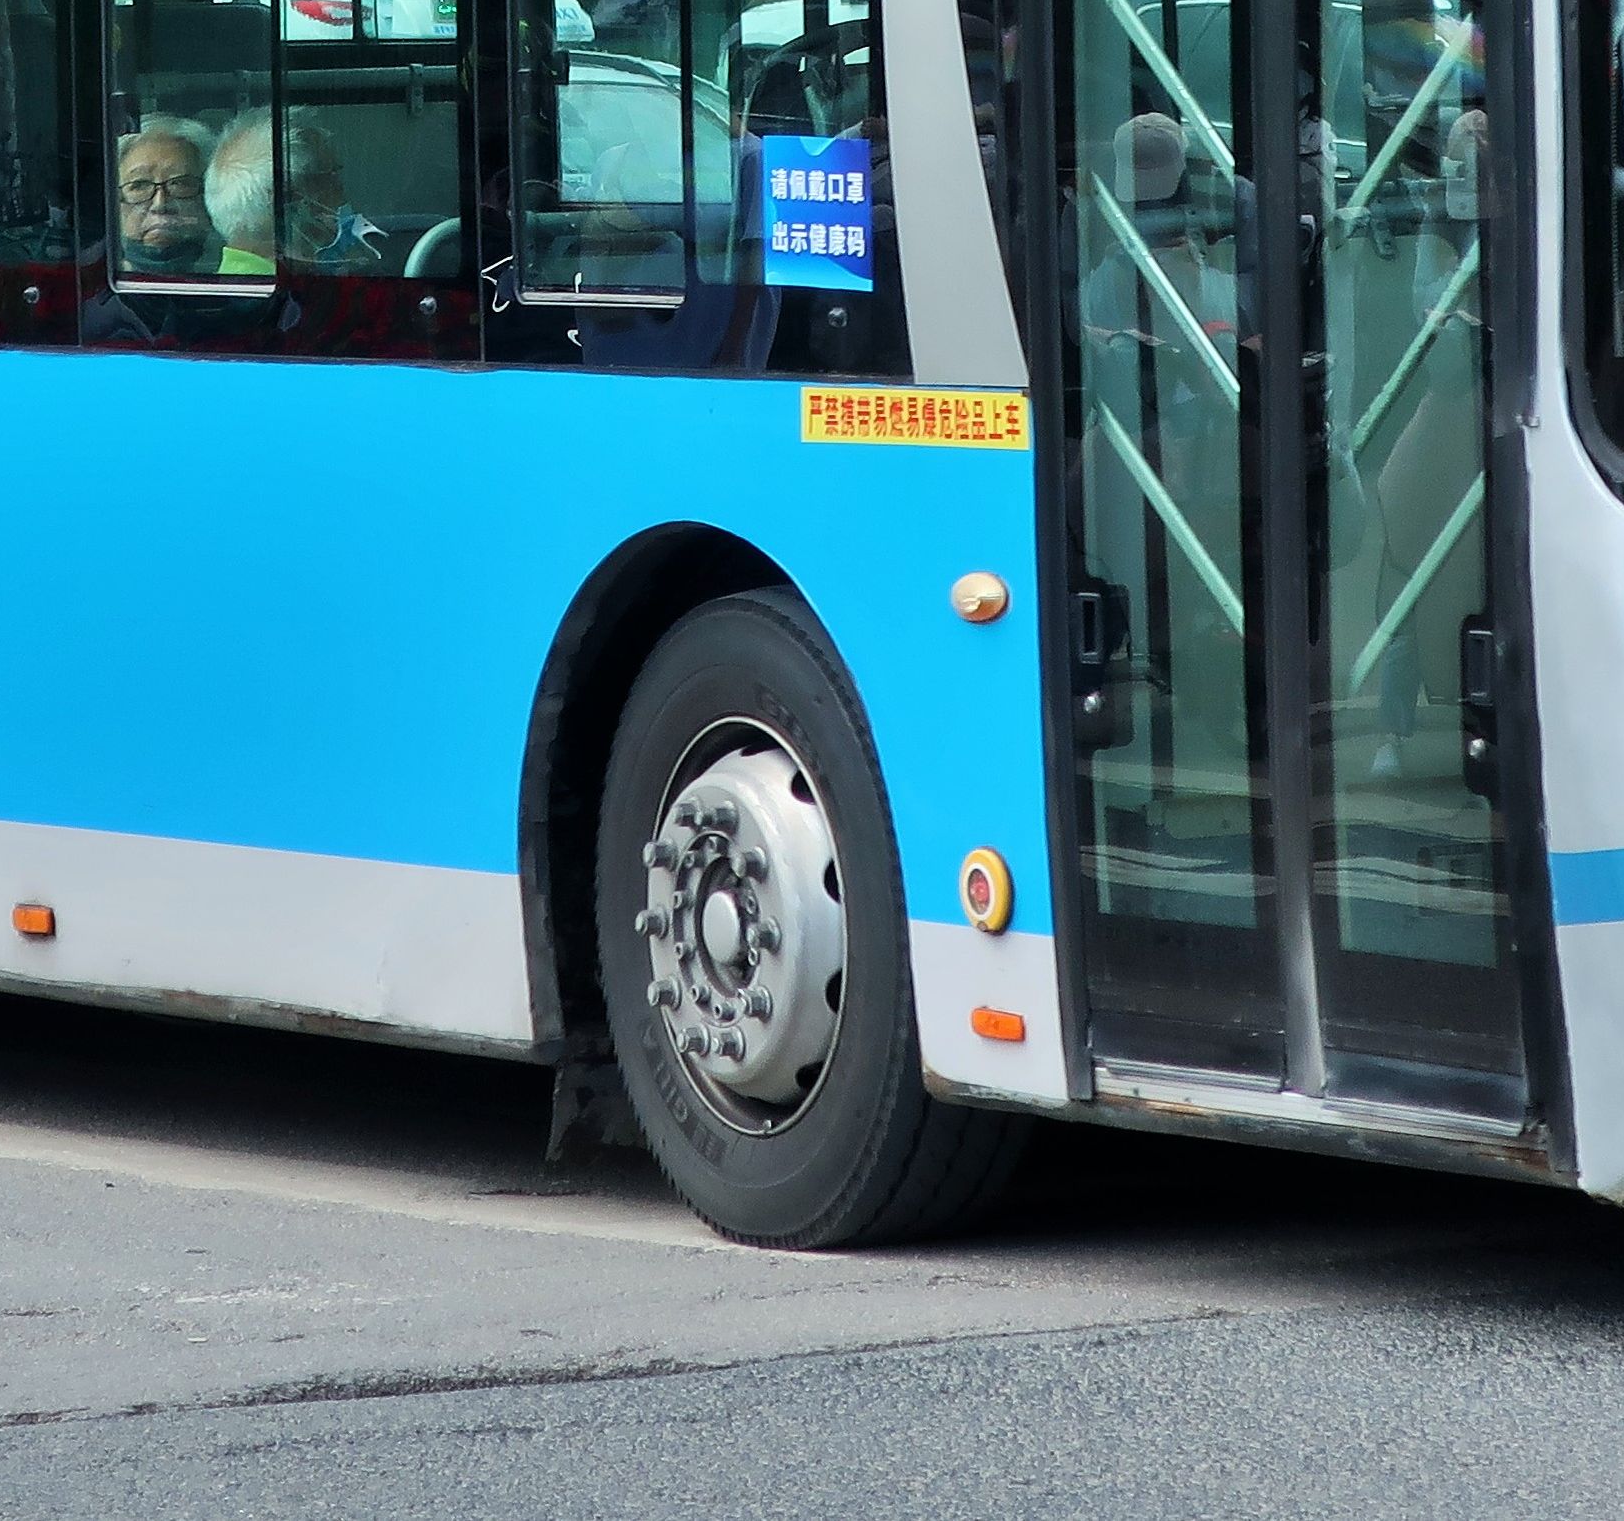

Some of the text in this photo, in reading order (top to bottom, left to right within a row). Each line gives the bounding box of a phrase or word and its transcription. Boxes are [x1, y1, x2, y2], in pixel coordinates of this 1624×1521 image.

[770, 168, 865, 205] 请佩戴口罩
[771, 220, 865, 258] 出示健康码
[809, 394, 1020, 442] 严禁携带易燃易爆危险品上车
